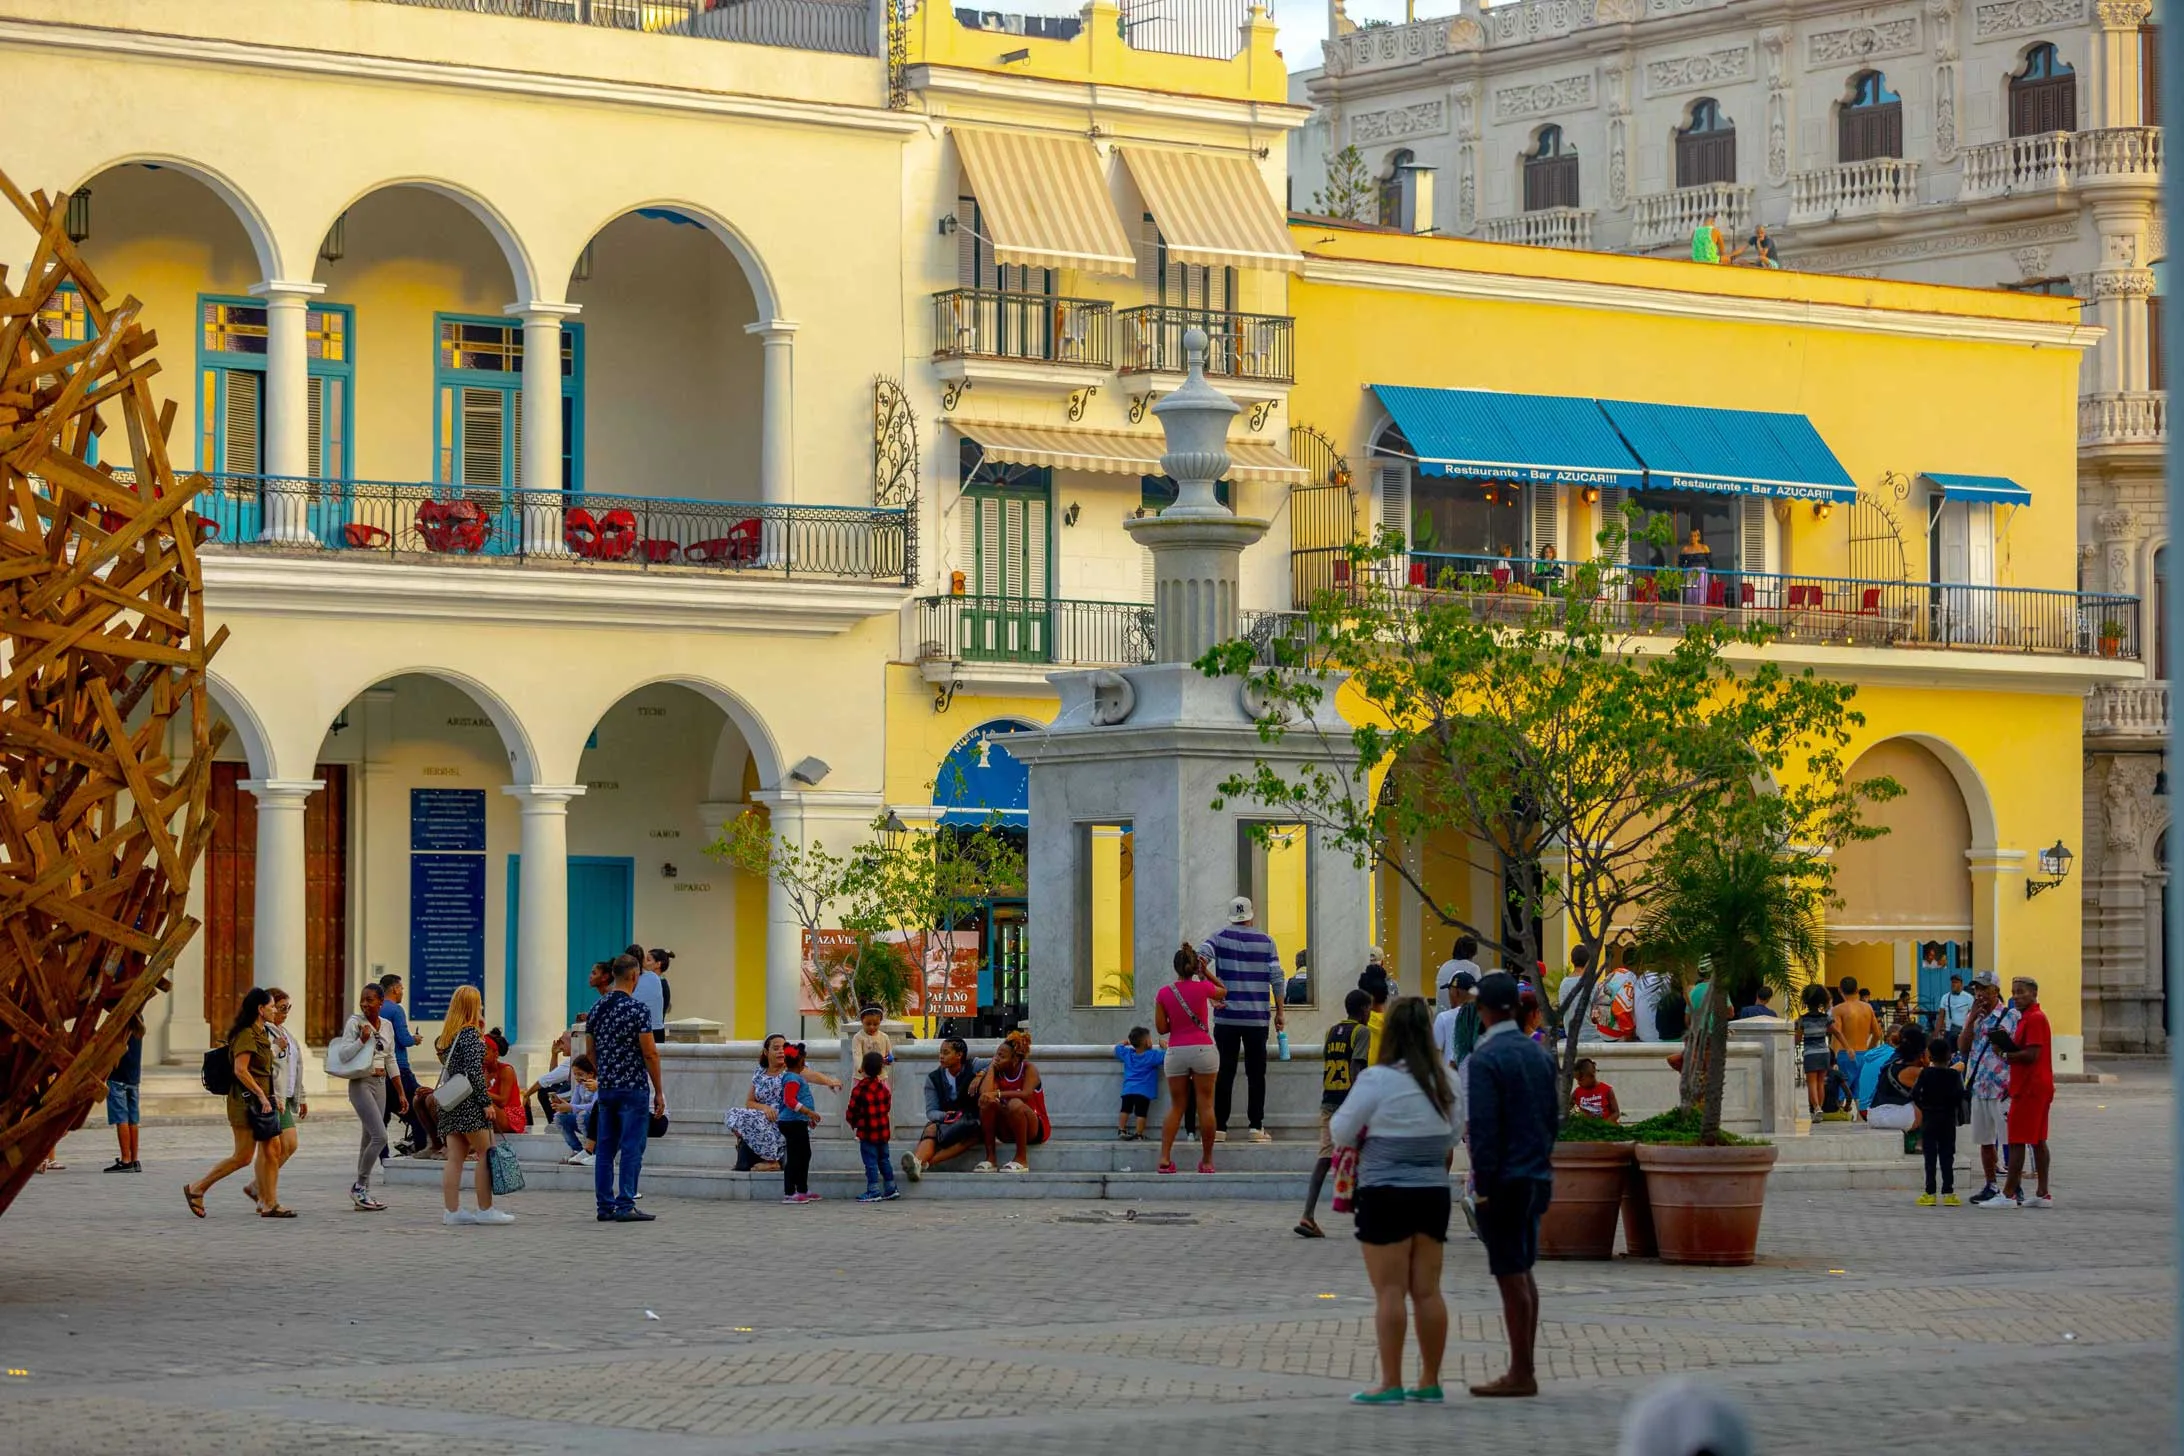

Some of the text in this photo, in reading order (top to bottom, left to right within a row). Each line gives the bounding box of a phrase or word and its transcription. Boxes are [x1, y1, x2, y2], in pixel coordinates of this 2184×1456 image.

[1445, 464, 1519, 478] Restaurante
[1530, 470, 1551, 480] Bar
[1556, 471, 1617, 484] AZUCAR!!!
[1673, 477, 1741, 492] Restaurante
[1752, 484, 1772, 494] Bar
[1776, 486, 1833, 499] AZUCAR!!!
[953, 728, 981, 753] NUEVA
[805, 934, 836, 945] PAZA
[953, 991, 968, 1001] NO
[1324, 1059, 1352, 1091] 23
